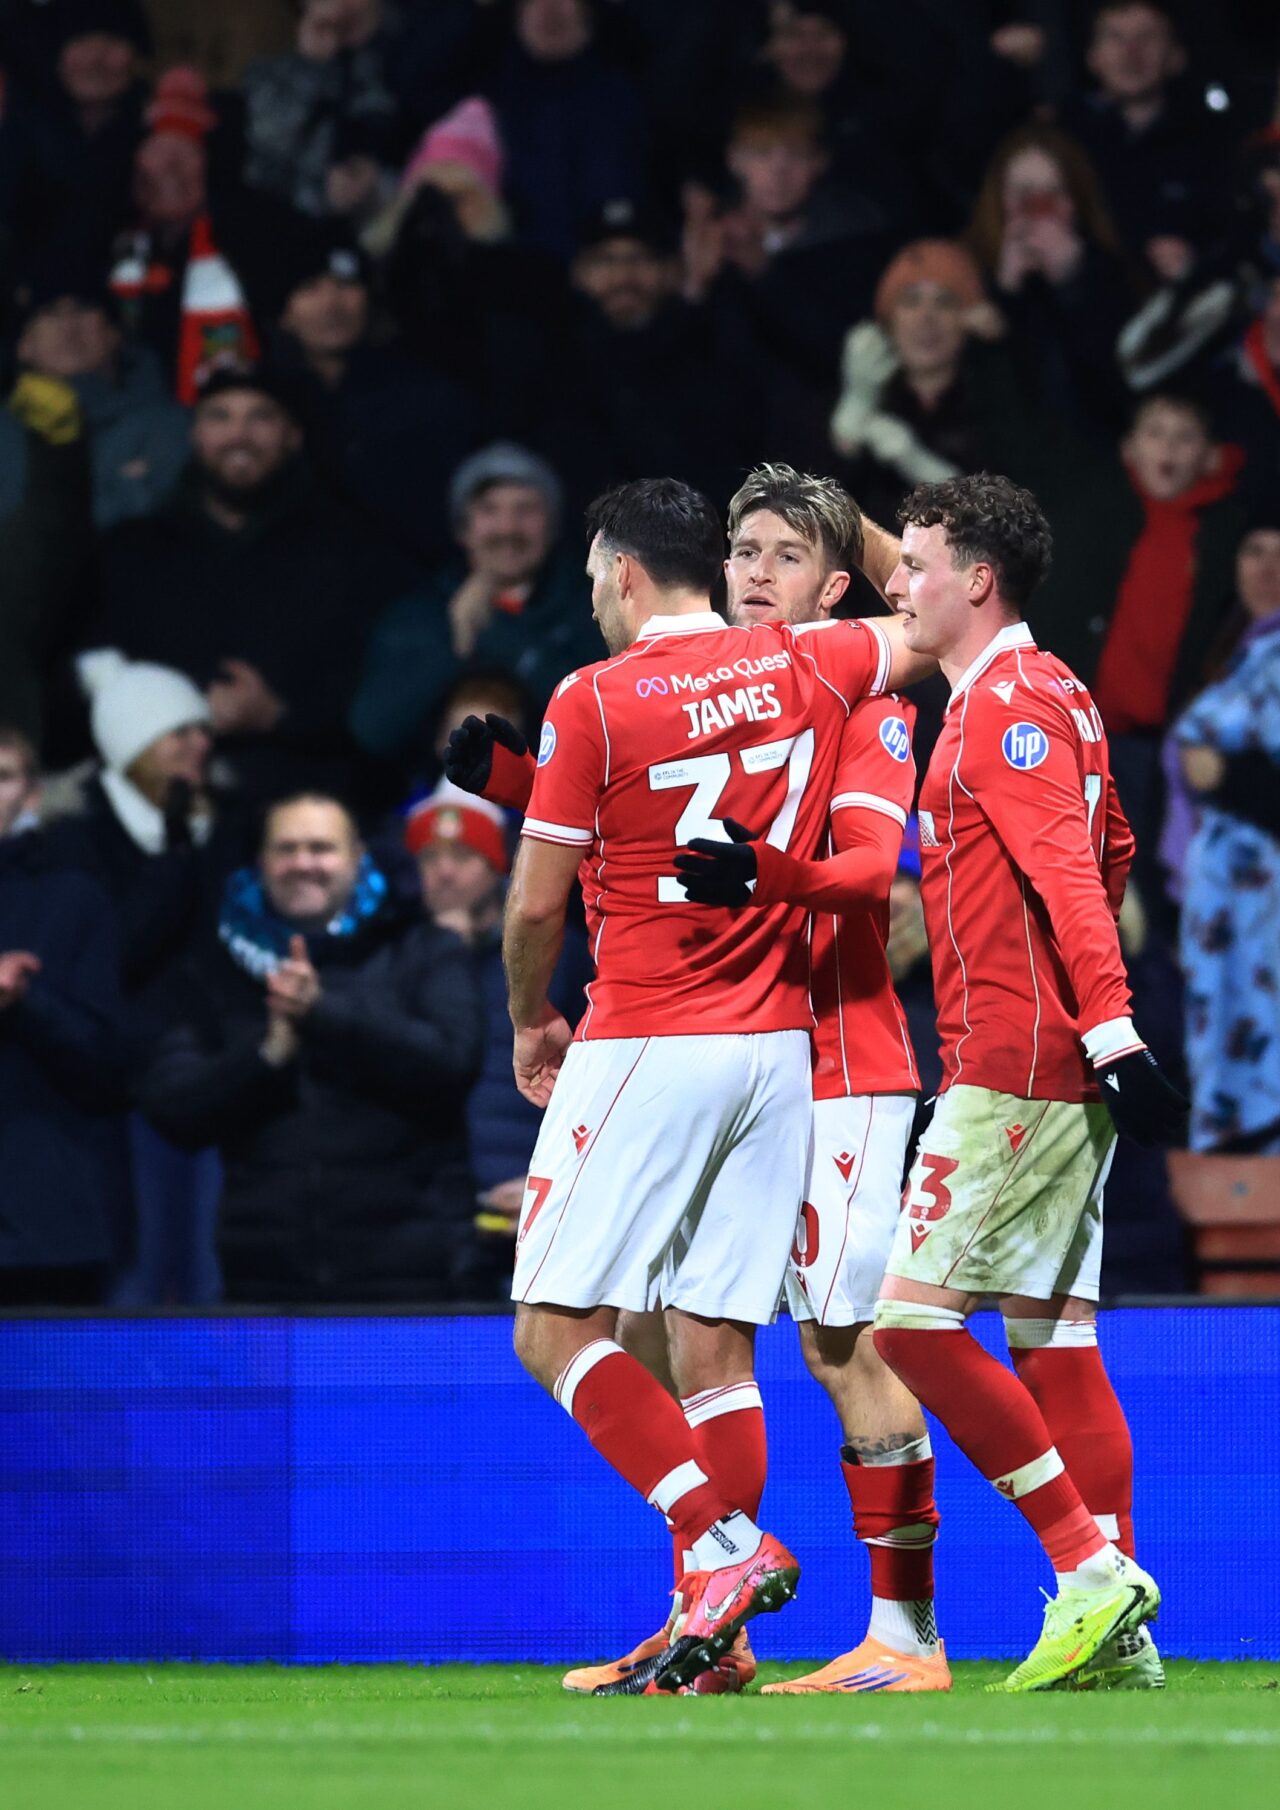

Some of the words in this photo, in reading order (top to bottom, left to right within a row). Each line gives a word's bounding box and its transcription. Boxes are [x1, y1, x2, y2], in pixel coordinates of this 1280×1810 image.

[669, 667, 734, 694] Meta
[733, 650, 792, 679] Quest
[682, 683, 782, 739] JAMES
[885, 722, 909, 761] hp
[1010, 731, 1042, 768] hp
